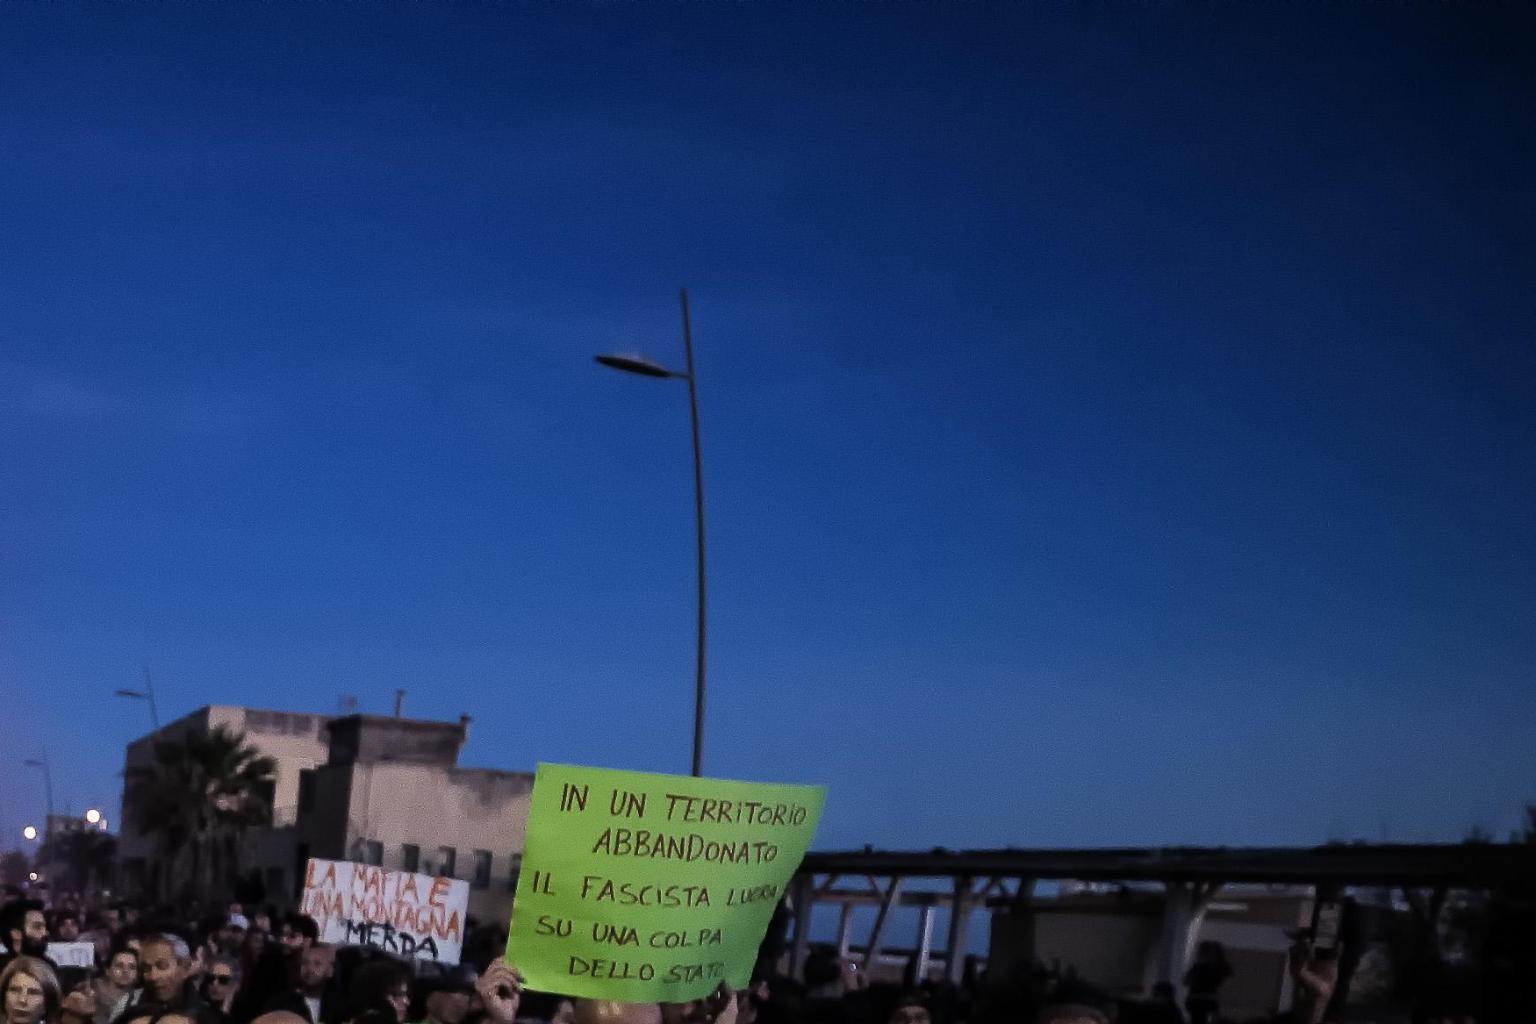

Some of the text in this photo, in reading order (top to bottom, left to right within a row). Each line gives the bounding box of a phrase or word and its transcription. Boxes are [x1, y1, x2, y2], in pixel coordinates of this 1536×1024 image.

[560, 782, 807, 826] IN UN TERRITORIO
[592, 827, 778, 865] ABBANDONATO
[532, 871, 556, 896] IL
[581, 875, 710, 908] FASCISTA
[345, 919, 439, 960] MERDA
[536, 915, 723, 950] SU UNA COLPA
[569, 956, 655, 981] DELLO
